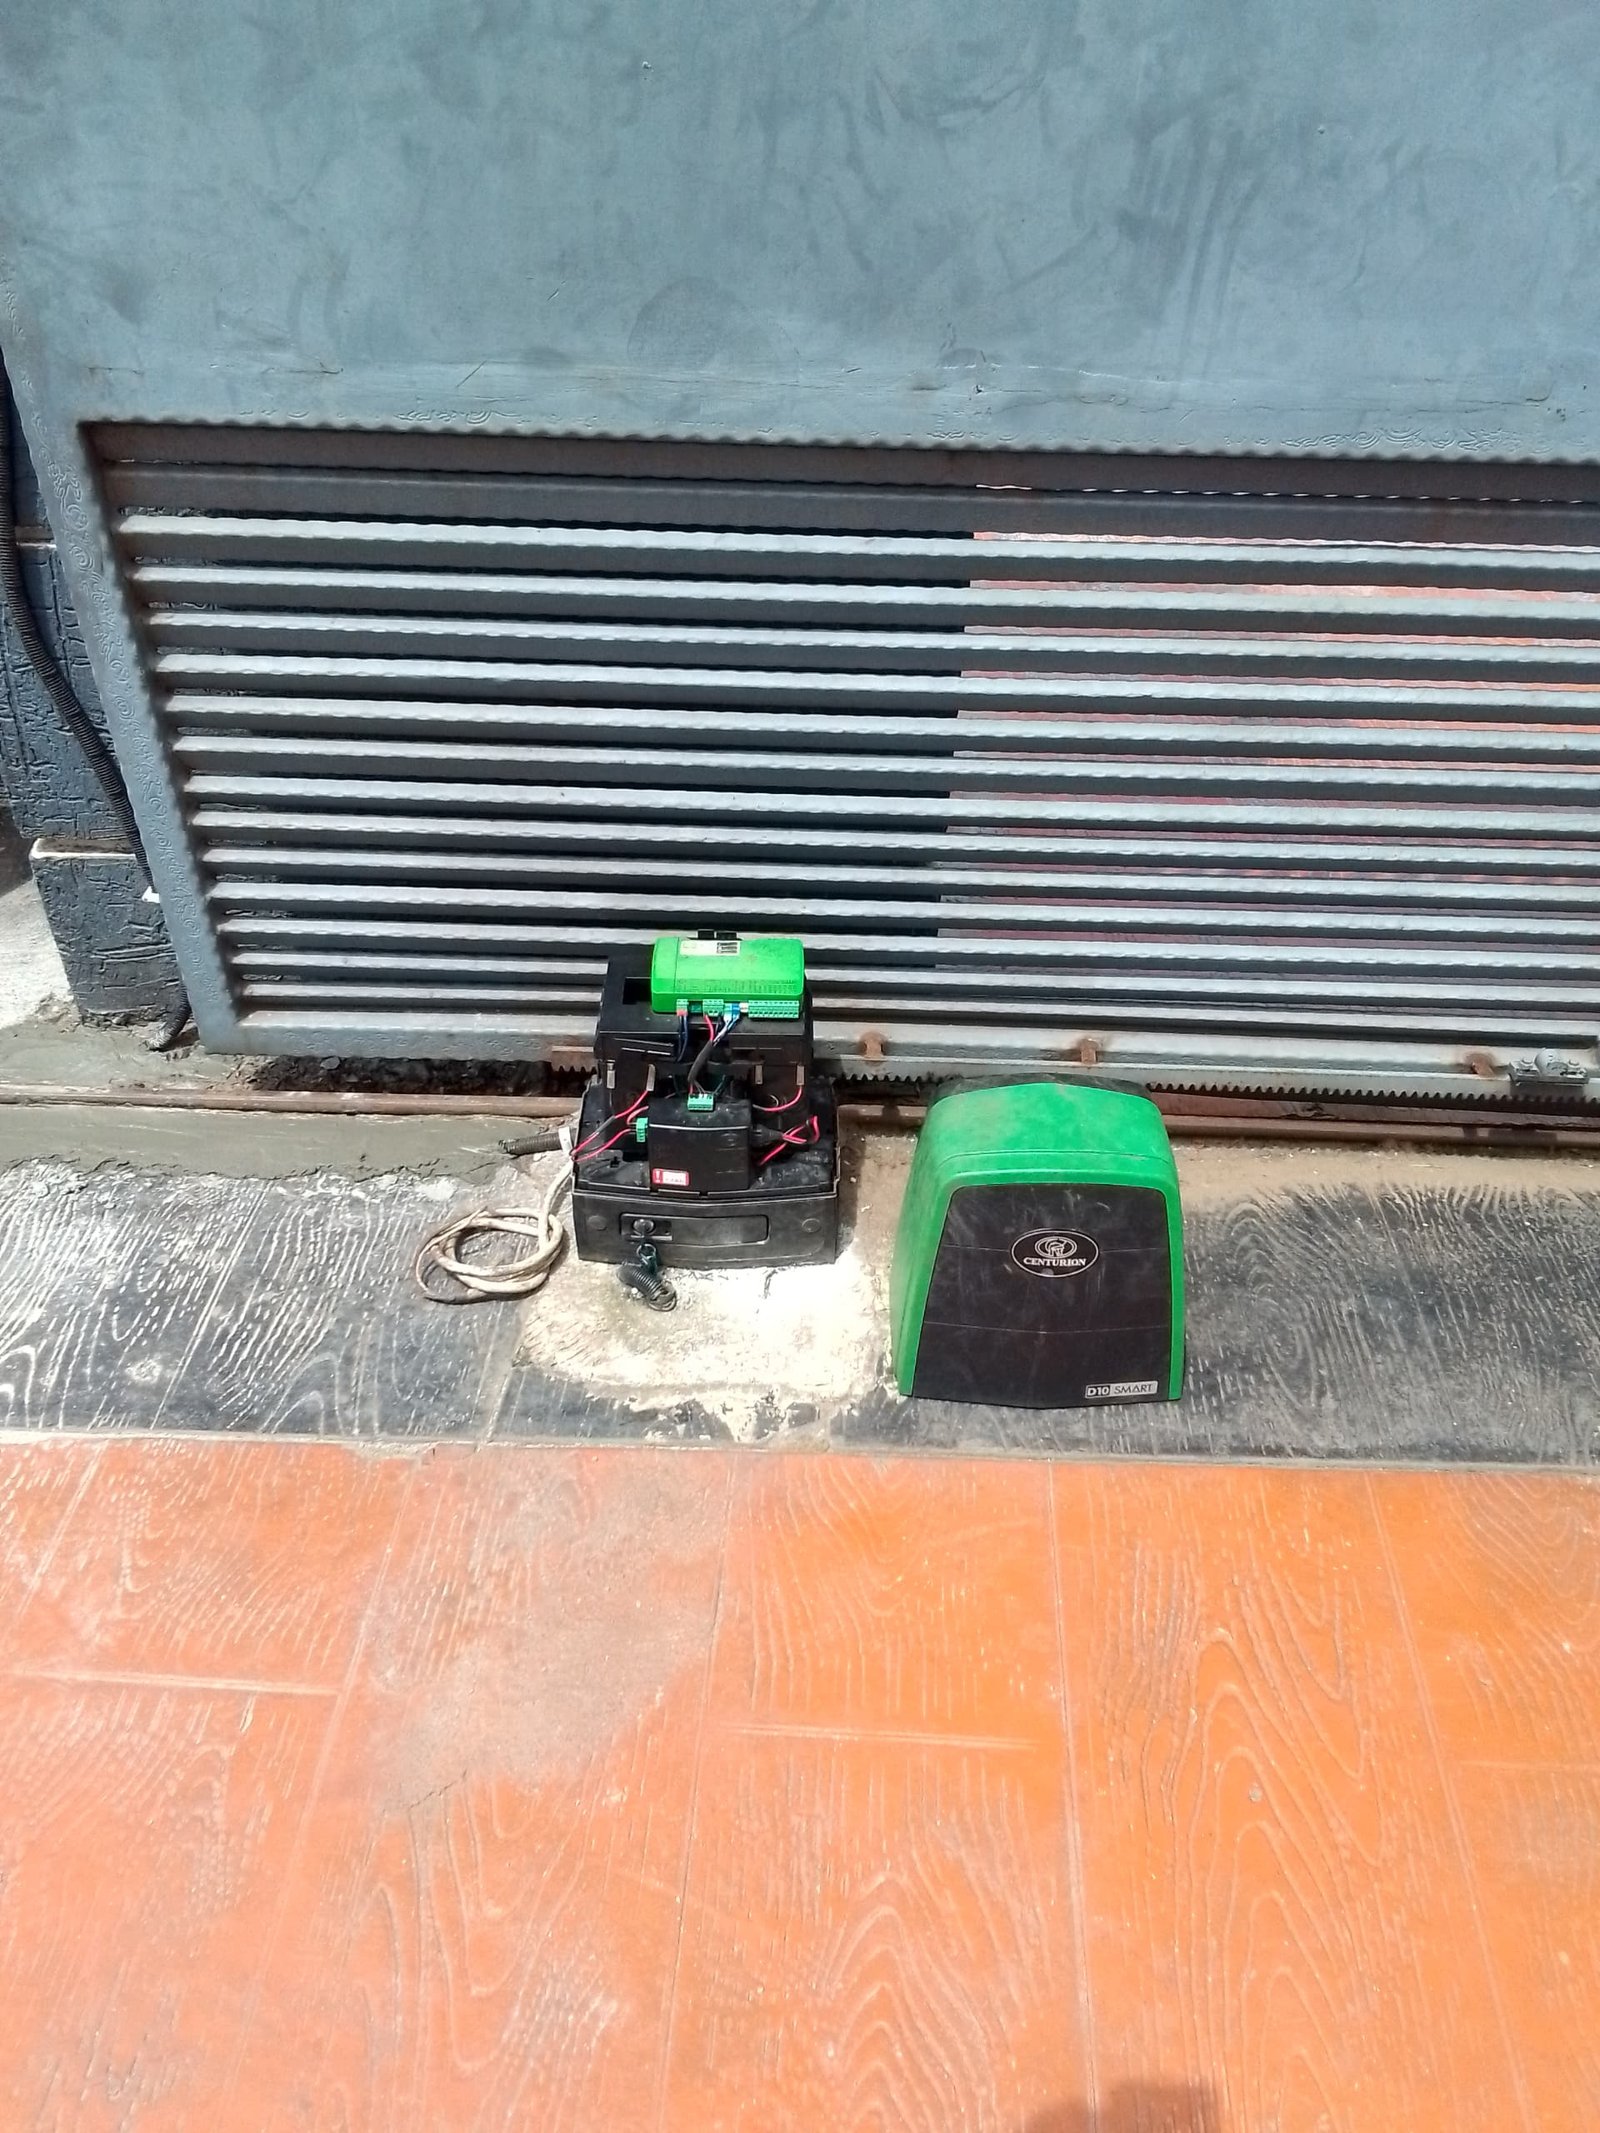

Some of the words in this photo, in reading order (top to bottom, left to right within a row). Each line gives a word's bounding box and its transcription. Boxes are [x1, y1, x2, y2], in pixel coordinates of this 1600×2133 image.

[1023, 1257, 1087, 1267] CENTURION
[1087, 1386, 1110, 1396] D10
[1114, 1384, 1152, 1394] SMART
